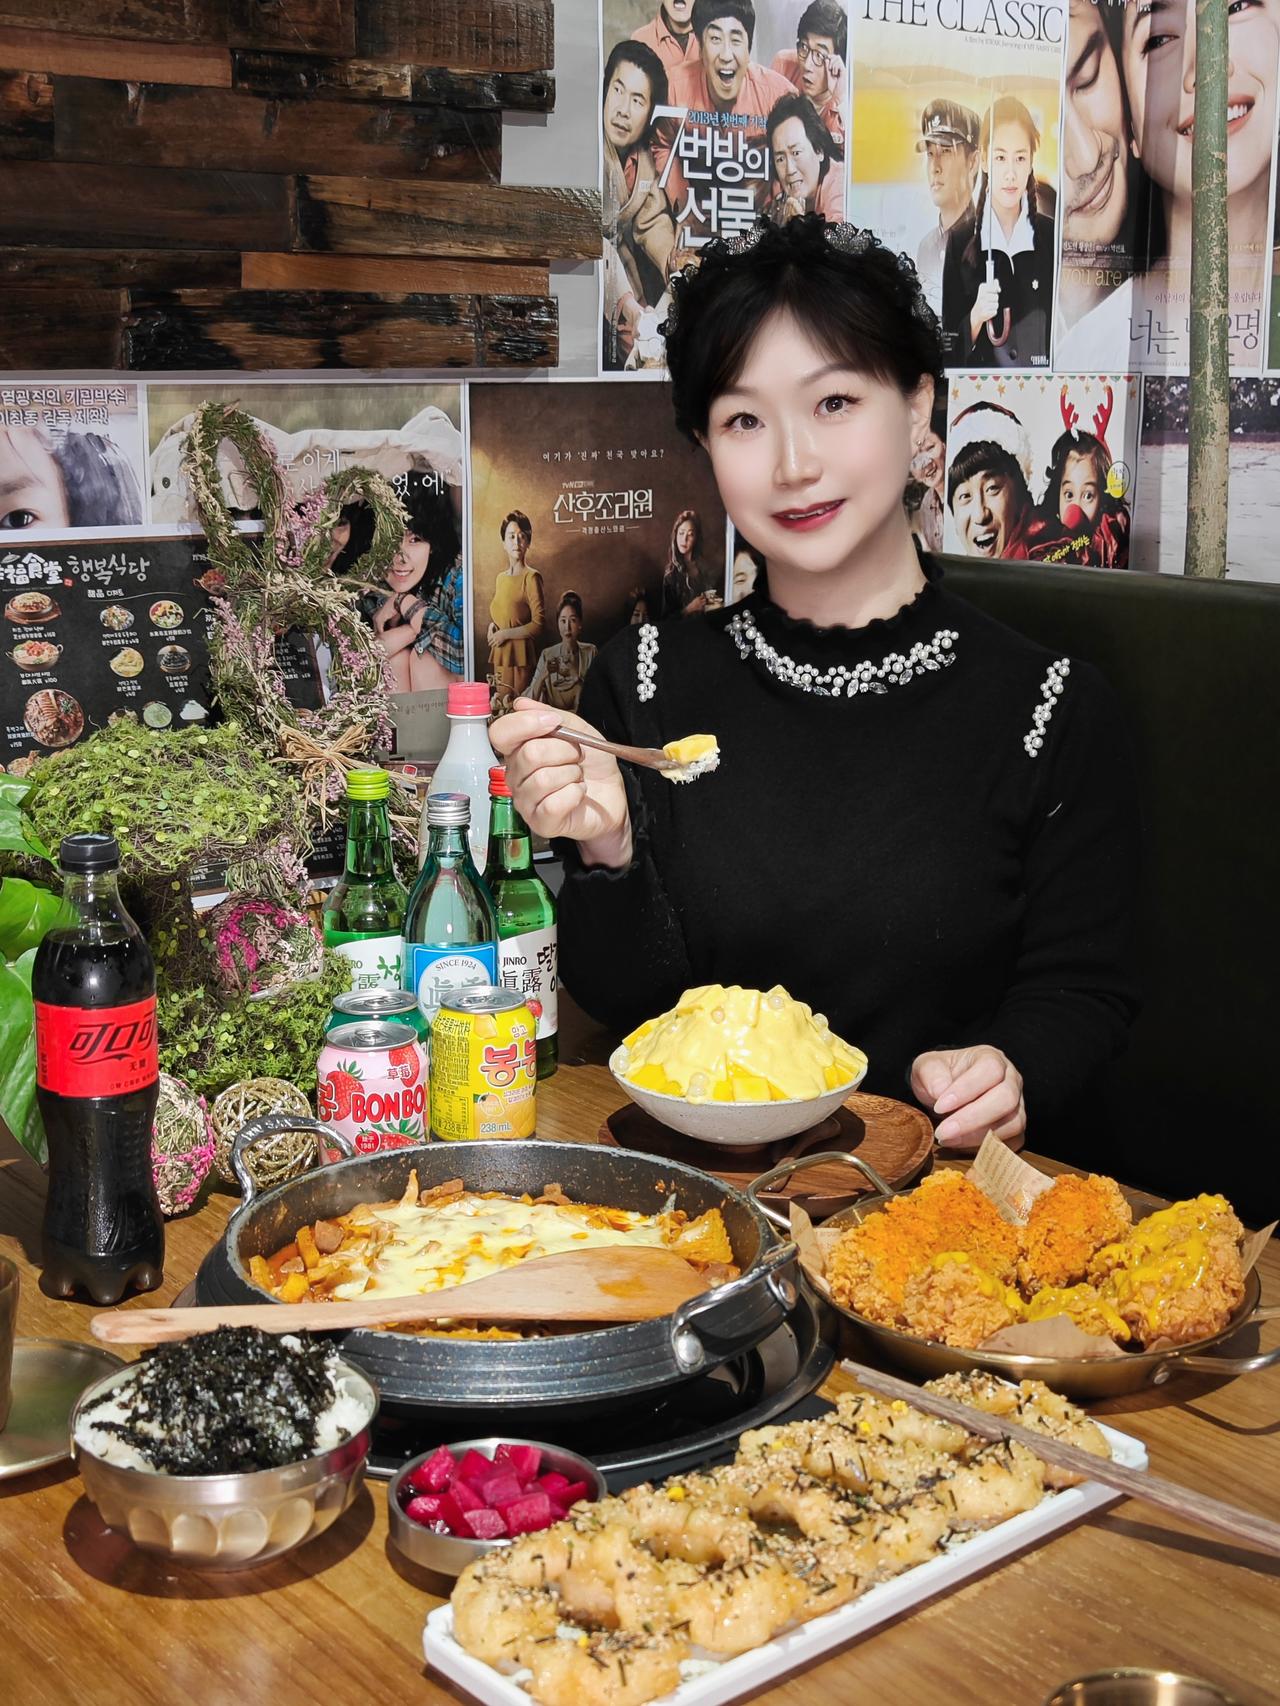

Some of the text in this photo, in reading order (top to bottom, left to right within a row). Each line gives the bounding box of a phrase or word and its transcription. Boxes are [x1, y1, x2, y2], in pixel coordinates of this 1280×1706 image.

[936, 0, 1064, 44] CLASSIC
[1095, 269, 1122, 287] are
[1128, 309, 1180, 356] 너는
[553, 488, 653, 524] 산후조리원
[0, 552, 63, 585] 福食堂
[66, 552, 150, 586] 행복식당
[435, 959, 477, 972] SINCE 1924
[503, 956, 527, 968] JINRO
[387, 1064, 411, 1080] 草莓
[480, 1123, 497, 1133] 238
